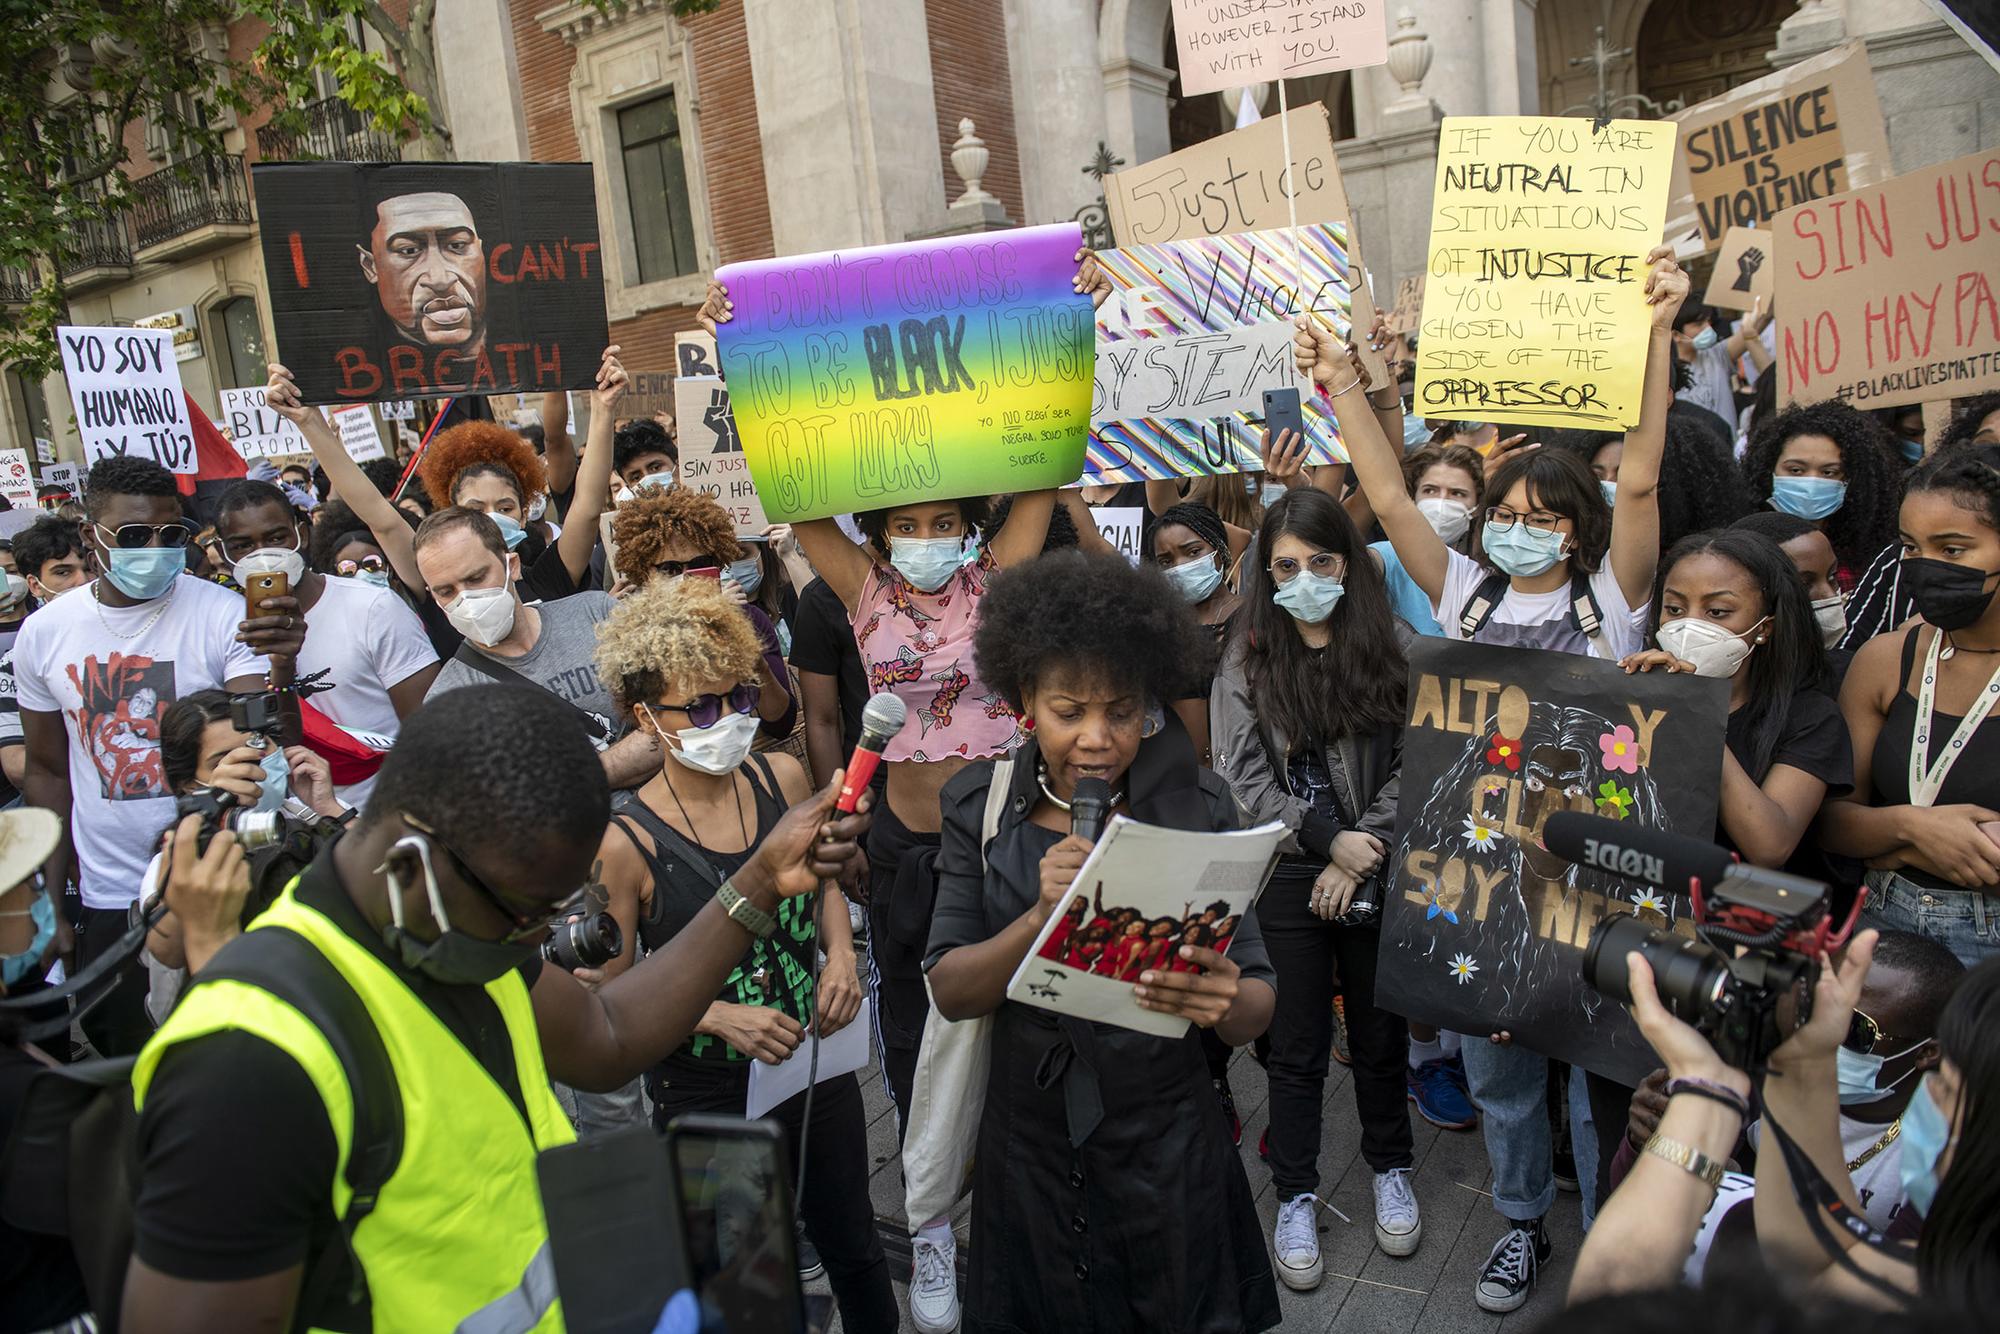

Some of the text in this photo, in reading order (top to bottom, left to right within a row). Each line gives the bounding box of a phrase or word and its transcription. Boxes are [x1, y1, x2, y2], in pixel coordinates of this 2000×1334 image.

[1288, 14, 1304, 34] I
[1310, 2, 1366, 29] STAND
[1449, 124, 1653, 154] IF YOU ARE
[1687, 85, 1838, 175] SILENCE
[1444, 163, 1644, 196] NEUTRAL IN
[1744, 154, 1781, 187] IS
[1433, 205, 1648, 233] SITUATIONS
[1794, 192, 1893, 281] SIN
[288, 230, 600, 289] I CAN'T
[1432, 247, 1639, 284] OF INJUSTICE
[737, 242, 1023, 335] I DIDN'T CHOOSE
[1445, 286, 1503, 312] YOU
[1531, 290, 1615, 319] HAVE
[1423, 318, 1616, 341] CHOSEN THE
[1785, 310, 1841, 396] NO
[1865, 283, 1943, 369] HAY
[66, 335, 163, 375] YO SOY
[334, 343, 562, 398] BREATH
[729, 340, 792, 419] TO
[805, 331, 856, 409] BE
[988, 309, 1004, 388] I
[1004, 302, 1094, 388] JUST
[1423, 348, 1613, 372] SIDE OF THE
[227, 390, 267, 409] PRO
[978, 417, 993, 427] YO
[1002, 410, 1021, 425] NO
[1052, 408, 1072, 419] SER
[142, 428, 192, 470] TÚ?
[766, 405, 941, 513] GOT LUCKY
[1160, 413, 1322, 475] GUIL
[52, 469, 71, 482] STOP
[1098, 525, 1140, 556] CIA!
[1410, 674, 1668, 768] ALTO Y
[1584, 838, 1665, 884] RØDE
[1405, 849, 1509, 922] SOY
